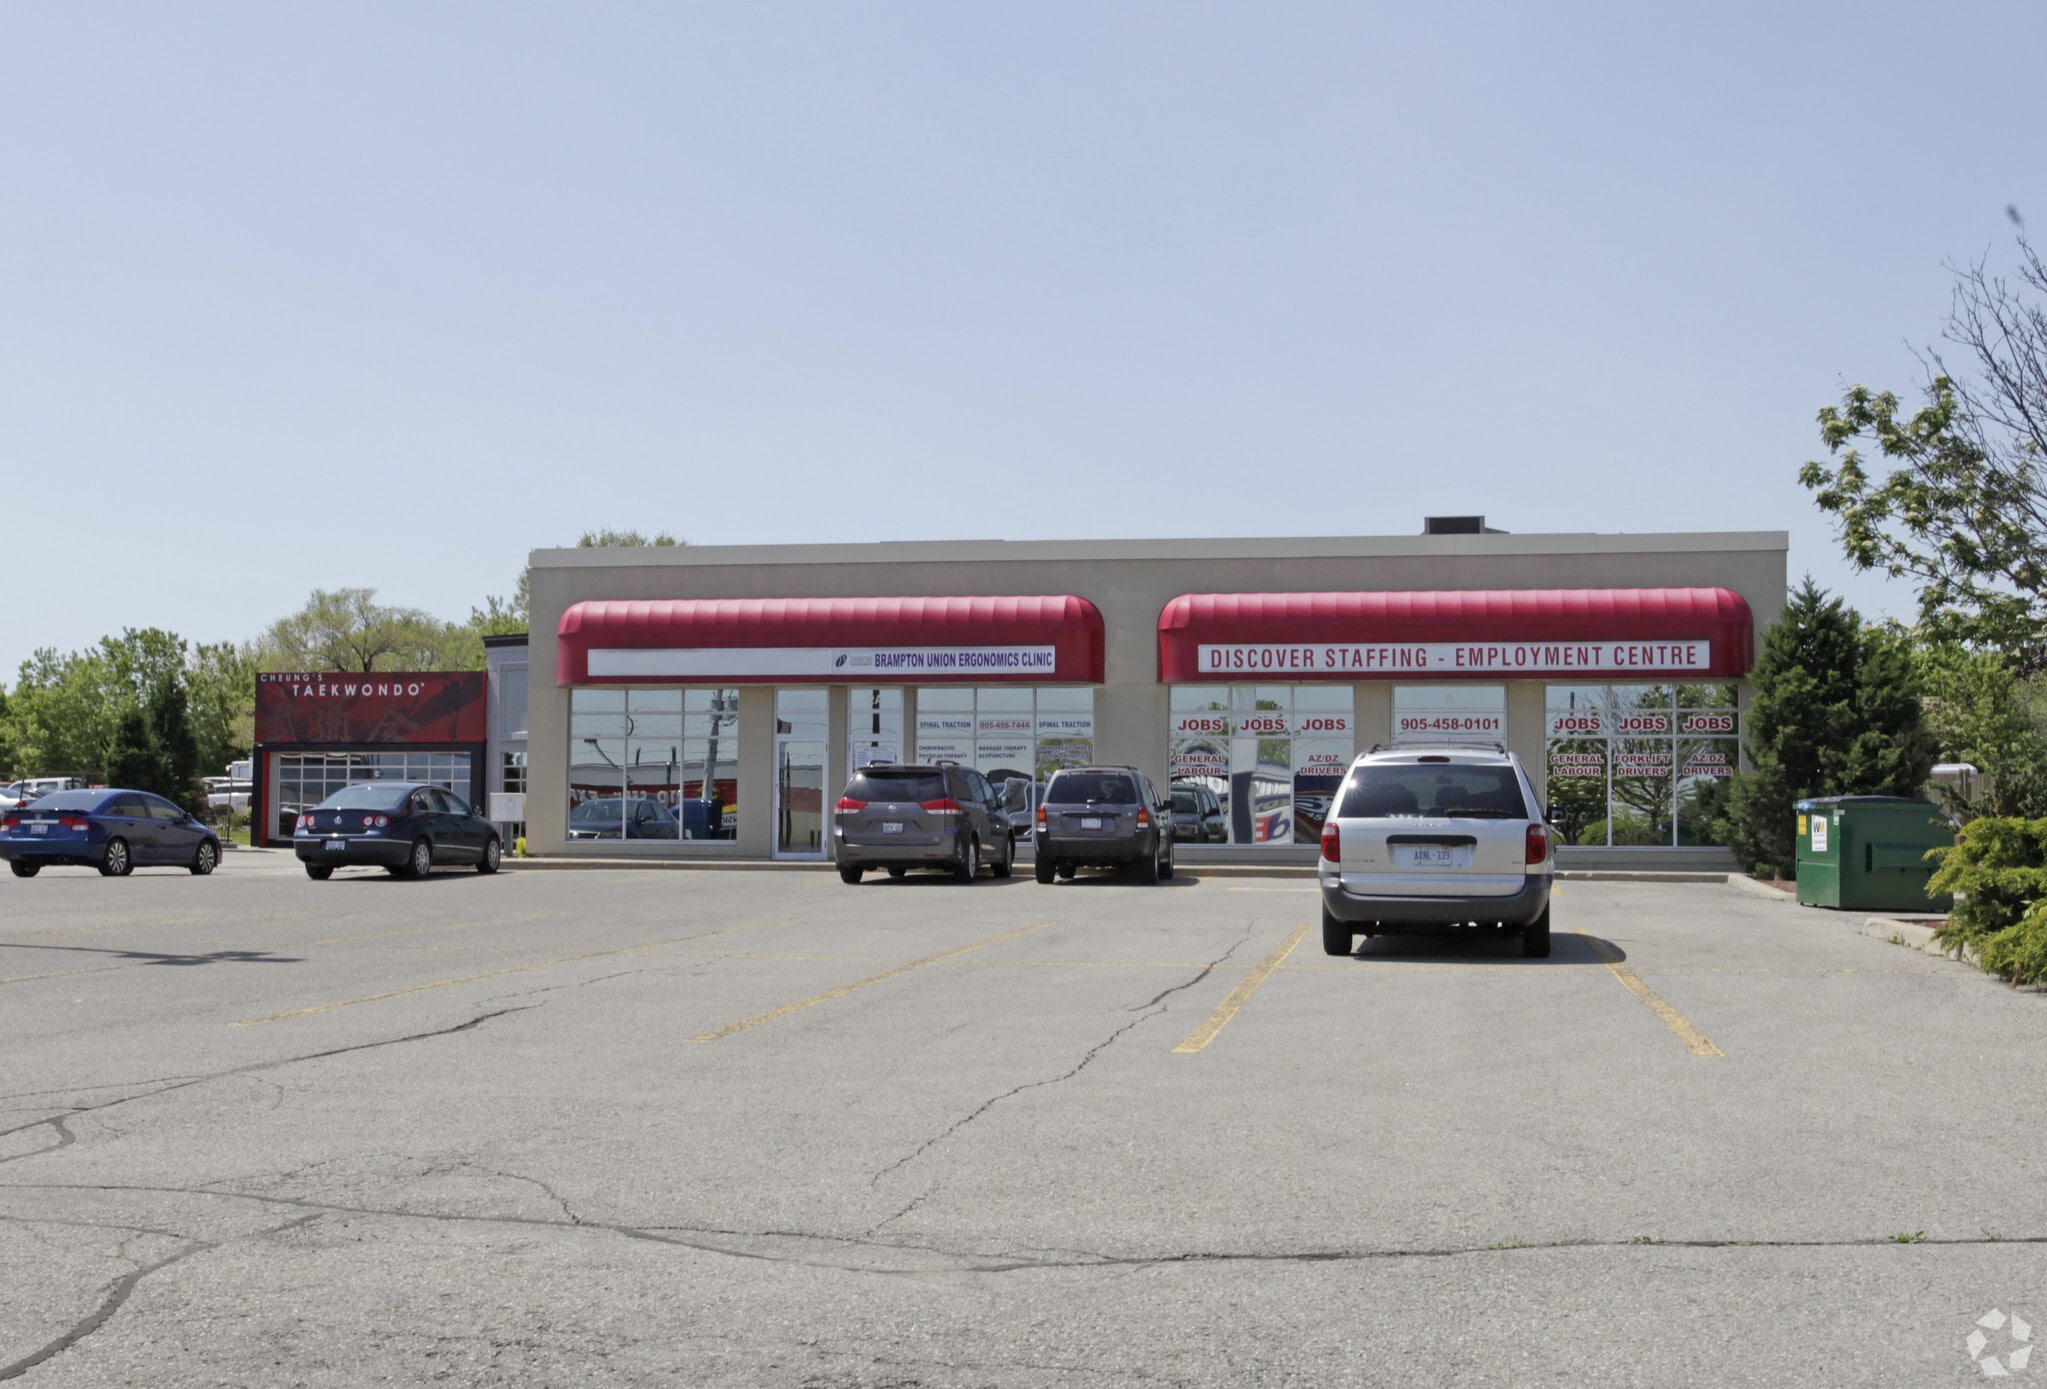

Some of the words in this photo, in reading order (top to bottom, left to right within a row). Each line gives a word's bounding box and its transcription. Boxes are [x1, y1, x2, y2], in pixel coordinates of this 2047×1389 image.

[874, 653, 924, 668] BRAMPTON
[926, 653, 956, 668] UNION
[958, 652, 1019, 667] ERGONOMICS
[1021, 652, 1052, 667] CLINIC
[1211, 648, 1314, 669] DISCOVER
[1325, 647, 1427, 668] STAFFING
[1455, 646, 1603, 667] EMPLOYMENT
[1613, 645, 1697, 666] CENTRE
[260, 673, 323, 682] CHEUNG'S
[292, 683, 420, 697] TAEKWONDO
[919, 721, 940, 729] SPINAL
[942, 721, 971, 729] TRACTION
[1038, 721, 1059, 729] SPINAL
[1061, 721, 1091, 729] TRACTION
[1177, 719, 1222, 731] JOBS
[1240, 719, 1285, 731] JOBS
[1301, 718, 1346, 731] JOBS
[1400, 718, 1499, 730] 905-458-0101
[1554, 718, 1600, 730] JOBS
[1619, 717, 1666, 730] JOBS
[1684, 717, 1732, 730] JOBS
[1174, 754, 1225, 763] GENERAL
[1308, 754, 1339, 763] AZ/DZ
[1551, 754, 1604, 764] GENERAL
[1614, 754, 1671, 764] FORKLIFT
[1691, 754, 1724, 764] AZ/DZ
[1177, 767, 1222, 775] LABOUR
[1300, 766, 1347, 775] DRIVERS
[1554, 766, 1600, 776] LABOUR
[1618, 766, 1667, 776] DRIVERS
[1683, 766, 1732, 776] DRIVERS
